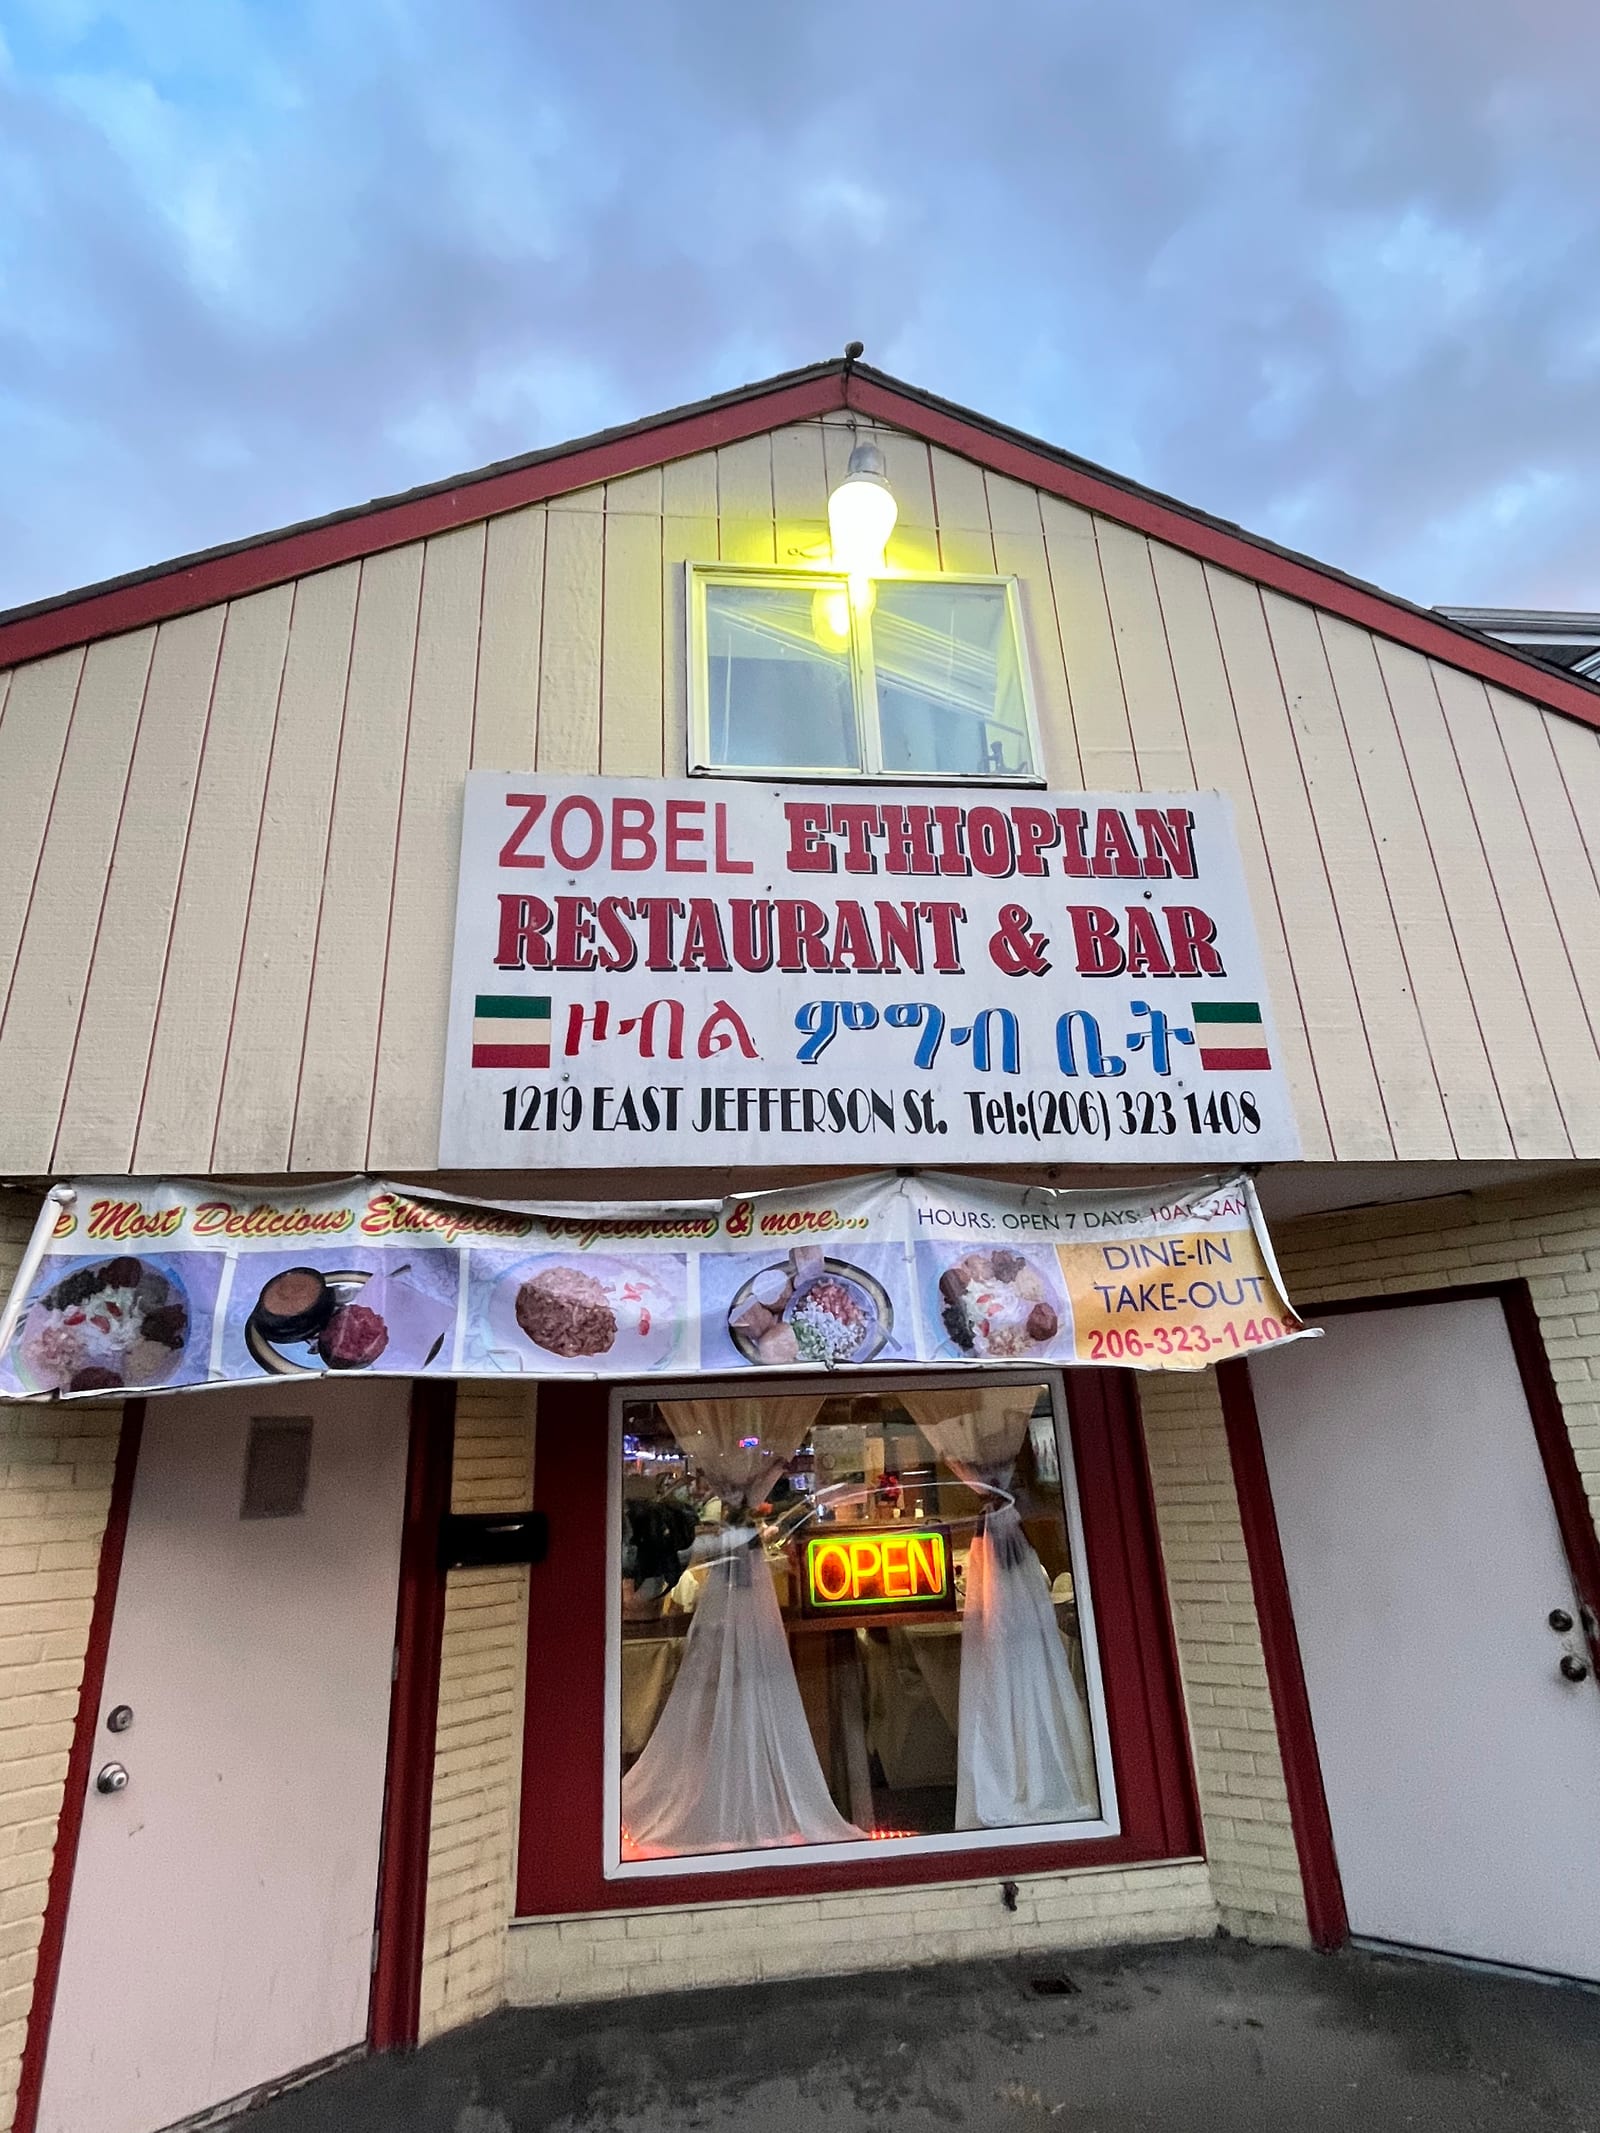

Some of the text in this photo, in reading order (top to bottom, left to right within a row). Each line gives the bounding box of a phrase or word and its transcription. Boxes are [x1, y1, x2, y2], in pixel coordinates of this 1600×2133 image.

[498, 793, 1199, 879] ZOBEL ETHIOPIAN
[493, 894, 1227, 978] RESTAURANT & BAR
[794, 1001, 1021, 1074] ምግብ
[1056, 1000, 1195, 1077] ቤት
[502, 1085, 582, 1132] 1219
[593, 1086, 684, 1132] EAST
[692, 1087, 895, 1134] JEFFERSON
[904, 1088, 948, 1135] St.
[1119, 1090, 1177, 1135] 323
[1184, 1090, 1261, 1135] 1408
[87, 1199, 187, 1241] Most
[193, 1200, 354, 1240] Delicious
[360, 1192, 533, 1244] Ethiopian
[726, 1201, 752, 1240] &
[918, 1207, 996, 1230] HOURS:
[1002, 1212, 1060, 1231] OPEN
[1065, 1213, 1077, 1230] 7
[1084, 1210, 1142, 1230] DAYS:
[1102, 1238, 1233, 1271] DINE-IN
[1094, 1276, 1265, 1313] TAKE-OUT
[814, 1538, 942, 1600] OPEN
